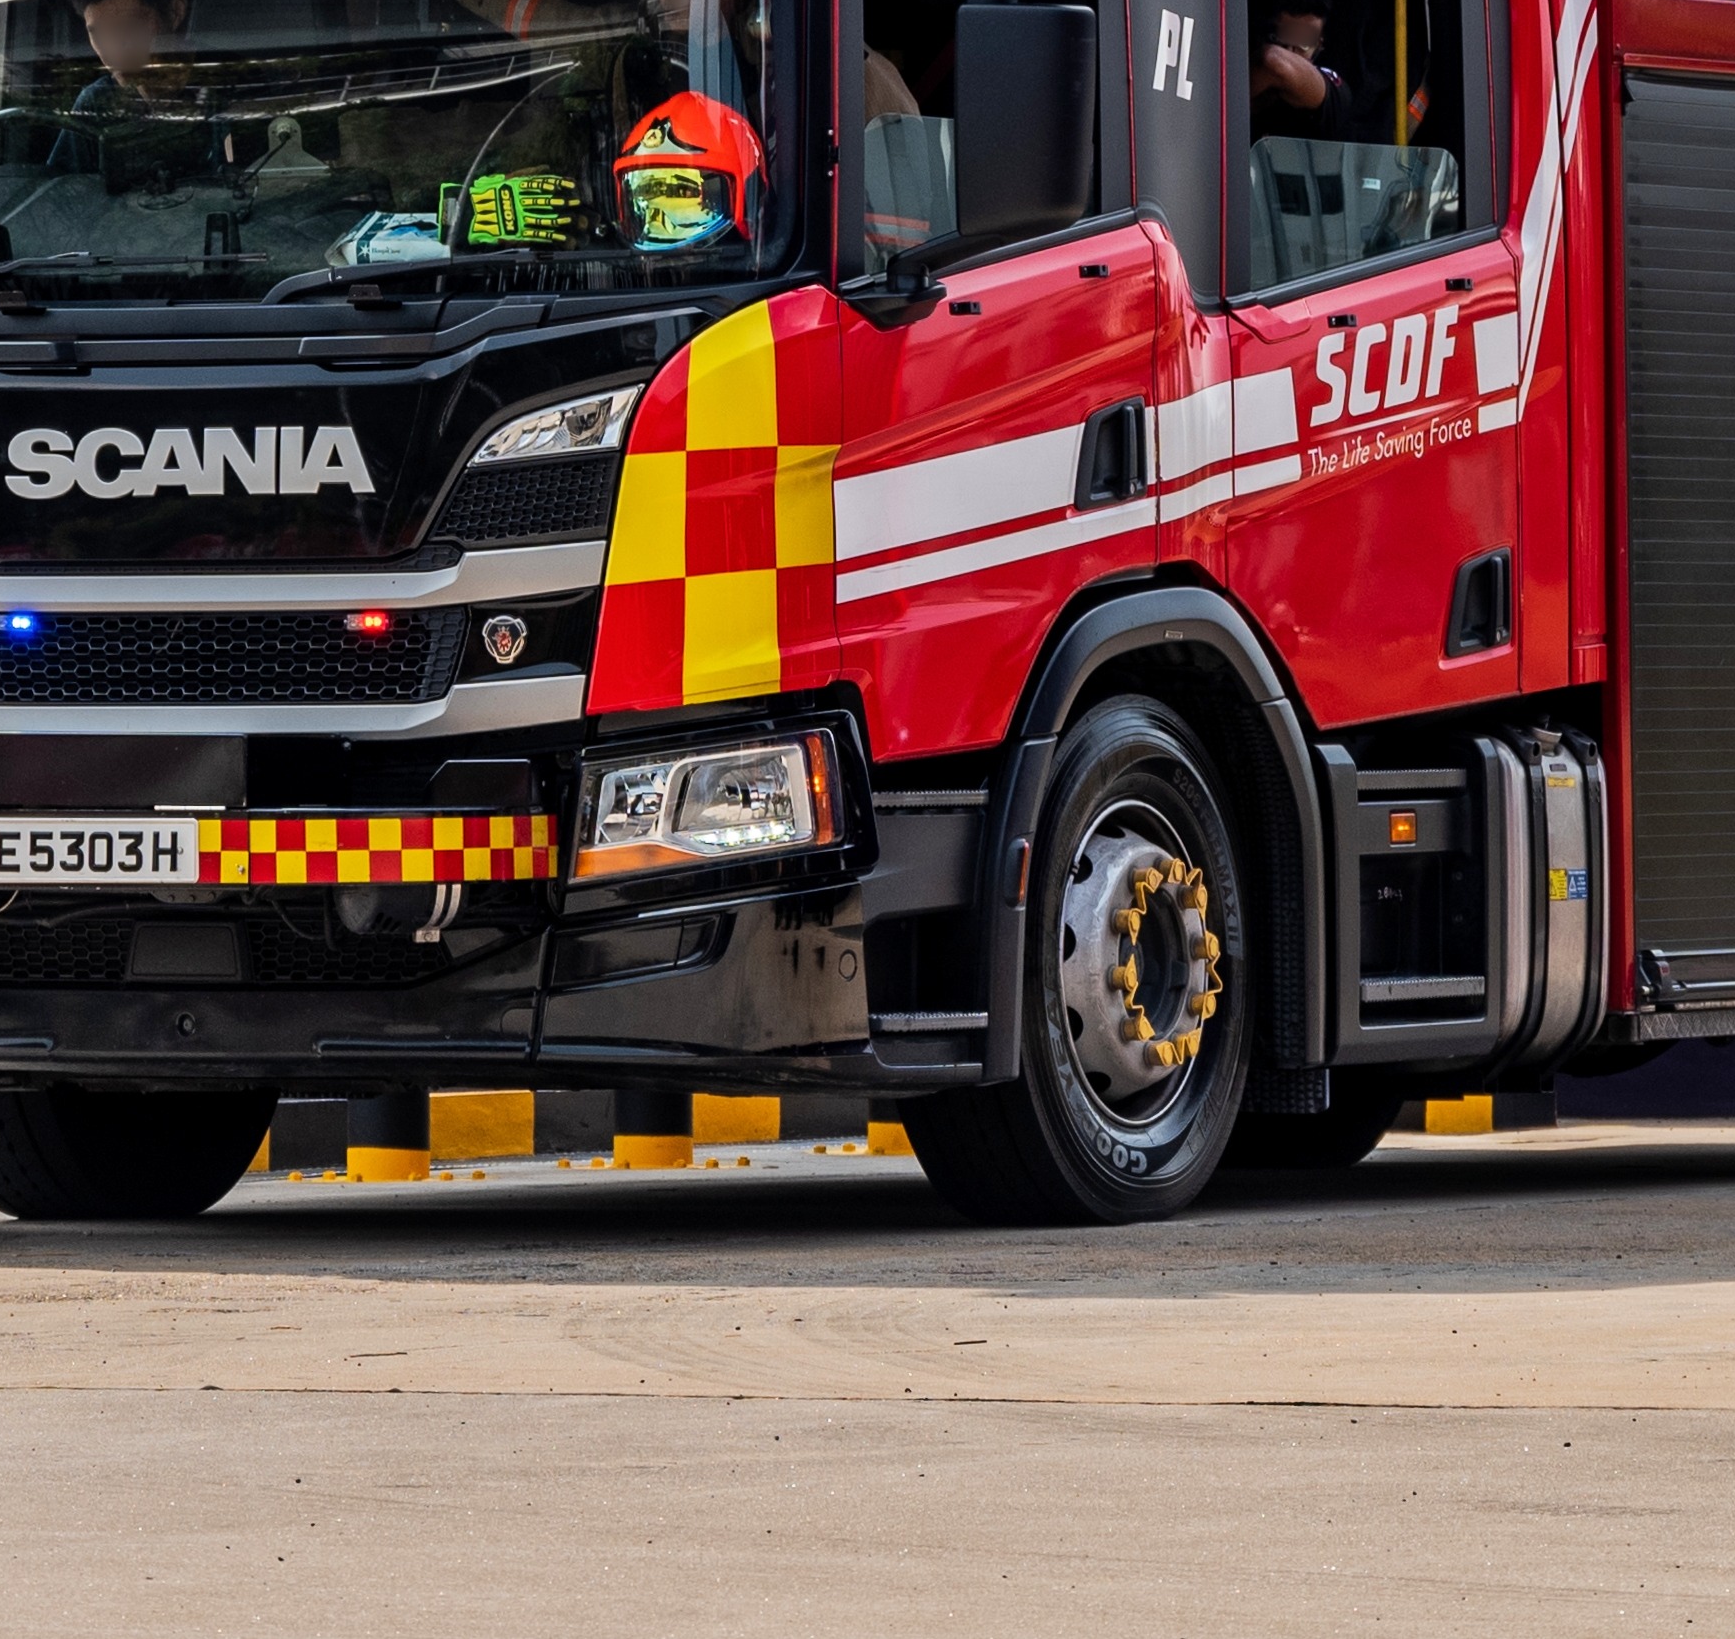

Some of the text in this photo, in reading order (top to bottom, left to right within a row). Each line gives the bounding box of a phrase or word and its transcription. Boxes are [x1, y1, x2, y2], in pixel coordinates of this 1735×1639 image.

[1152, 8, 1194, 101] PL
[501, 189, 515, 231] KONG
[1310, 304, 1459, 427] SCDF
[5, 426, 376, 499] SCANIA
[1308, 417, 1472, 477] The Life Saving Force
